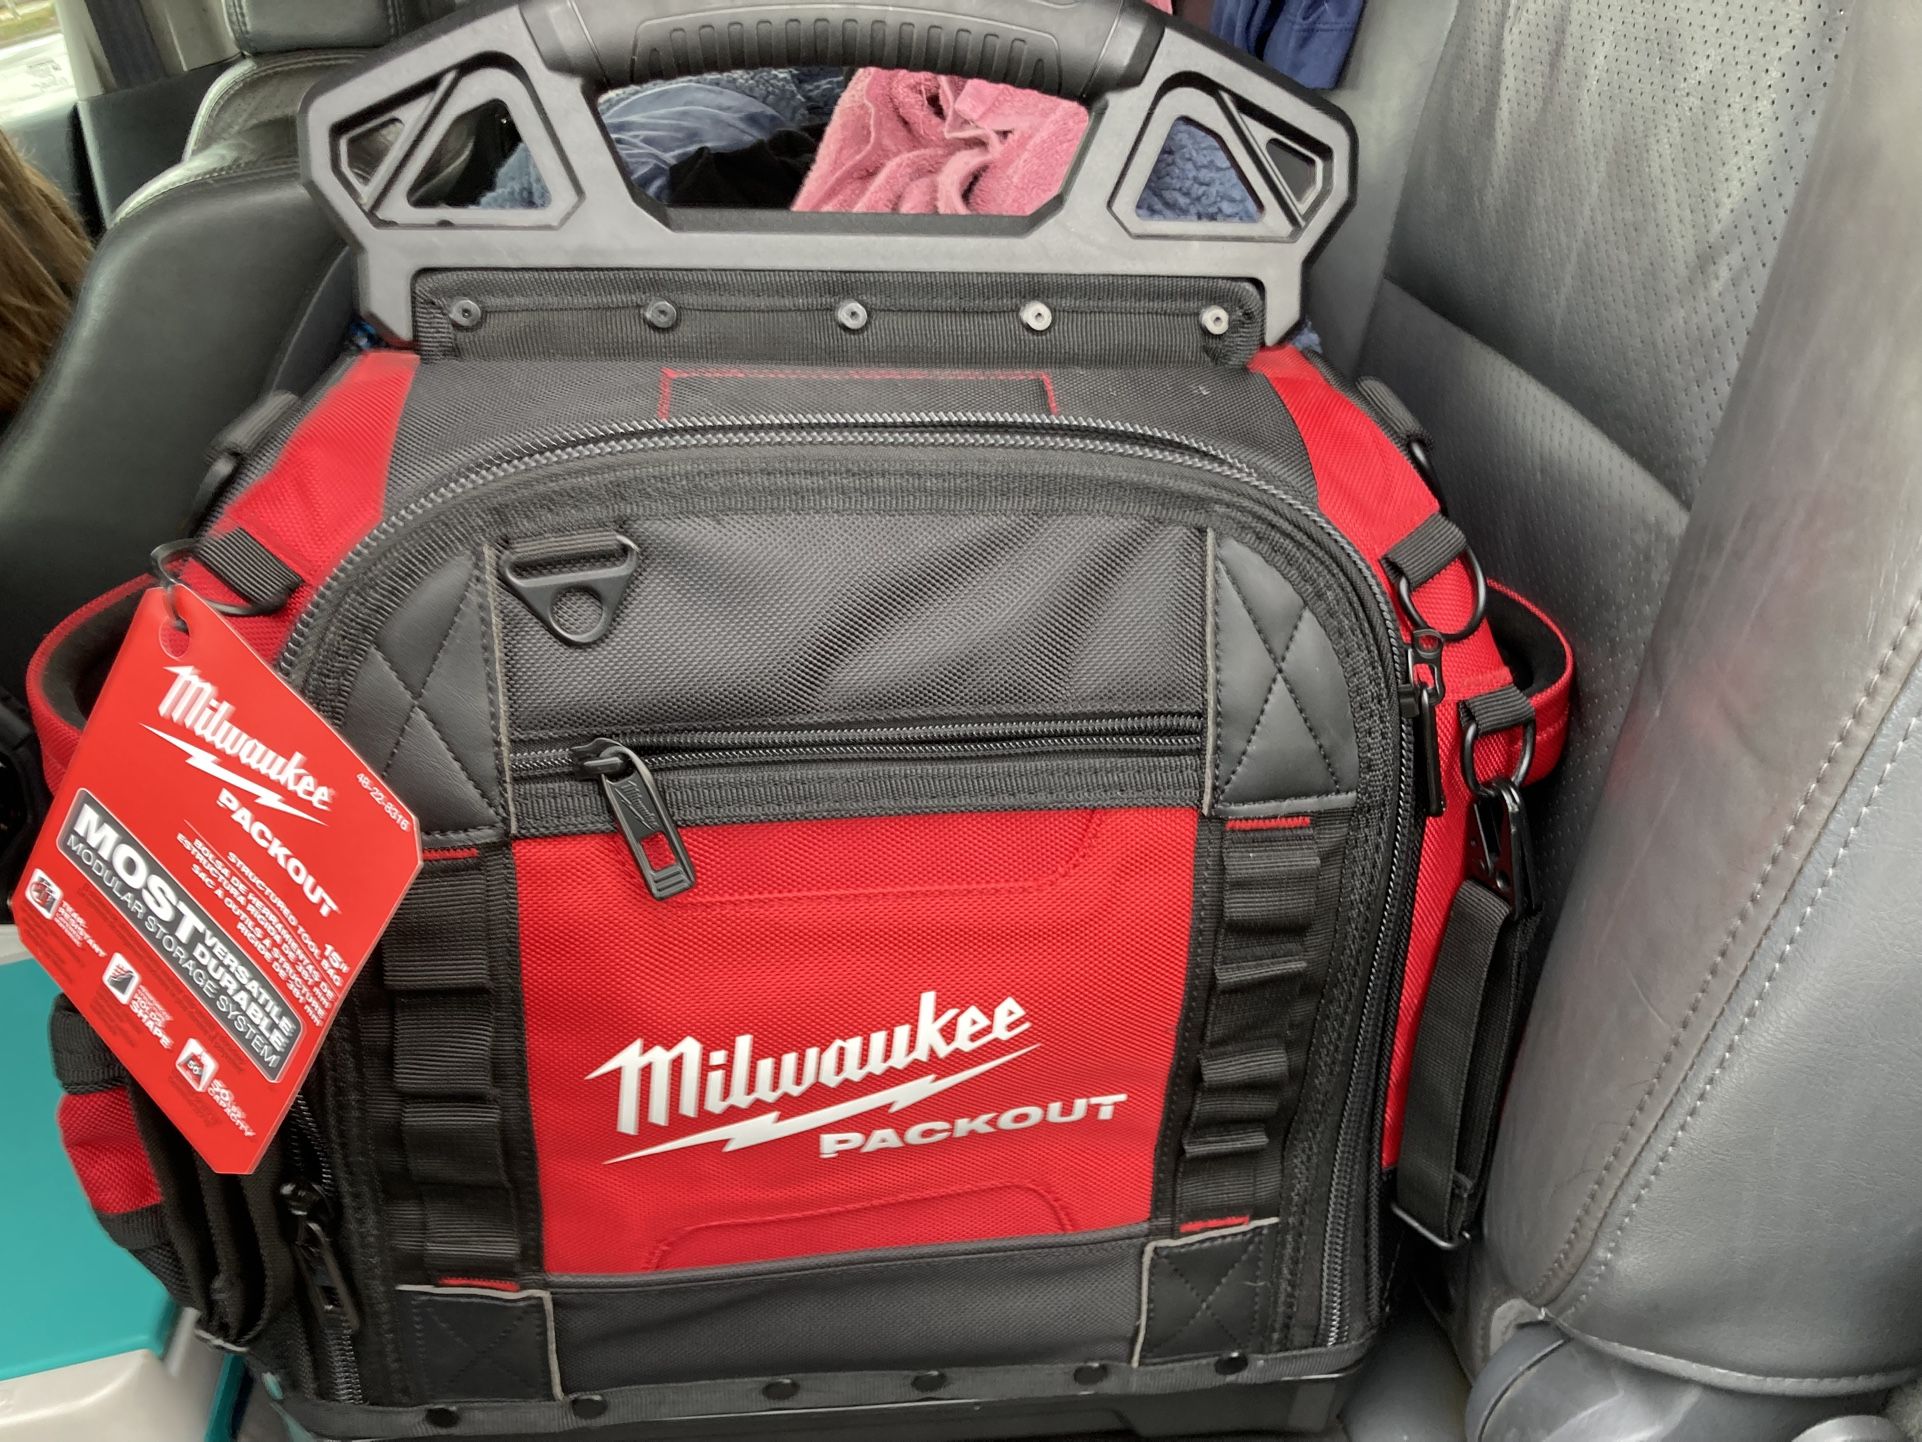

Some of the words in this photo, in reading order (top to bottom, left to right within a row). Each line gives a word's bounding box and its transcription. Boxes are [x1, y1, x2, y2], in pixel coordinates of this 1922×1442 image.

[157, 664, 337, 811] Milwaukee
[355, 769, 412, 833] 48-22-8316
[73, 802, 207, 948] MOST
[176, 831, 247, 907] ESTRUCTURA
[281, 941, 297, 963] DE
[193, 837, 231, 880] BOLSA
[230, 874, 249, 897] DE
[246, 890, 322, 984] HERRAMIENTAS
[319, 978, 335, 1002] DE
[216, 784, 341, 920] PACKOUT
[227, 849, 298, 926] STRUCTURED
[295, 923, 323, 961] TOOL
[320, 956, 343, 988] BAG
[66, 831, 147, 920] MODULAR
[143, 912, 219, 1000] STORAGE
[215, 991, 280, 1066] SYSTEM
[190, 861, 216, 890] SAC
[223, 894, 264, 940] OUTILS
[270, 944, 326, 1020] STRUCTURE
[192, 940, 288, 1051] DURABLE
[206, 928, 295, 1037] VERSATILE
[271, 958, 288, 982] DE
[129, 998, 174, 1049] SHAPE
[584, 990, 1031, 1136] Milwaukee
[819, 1094, 1127, 1158] PACKOUT
